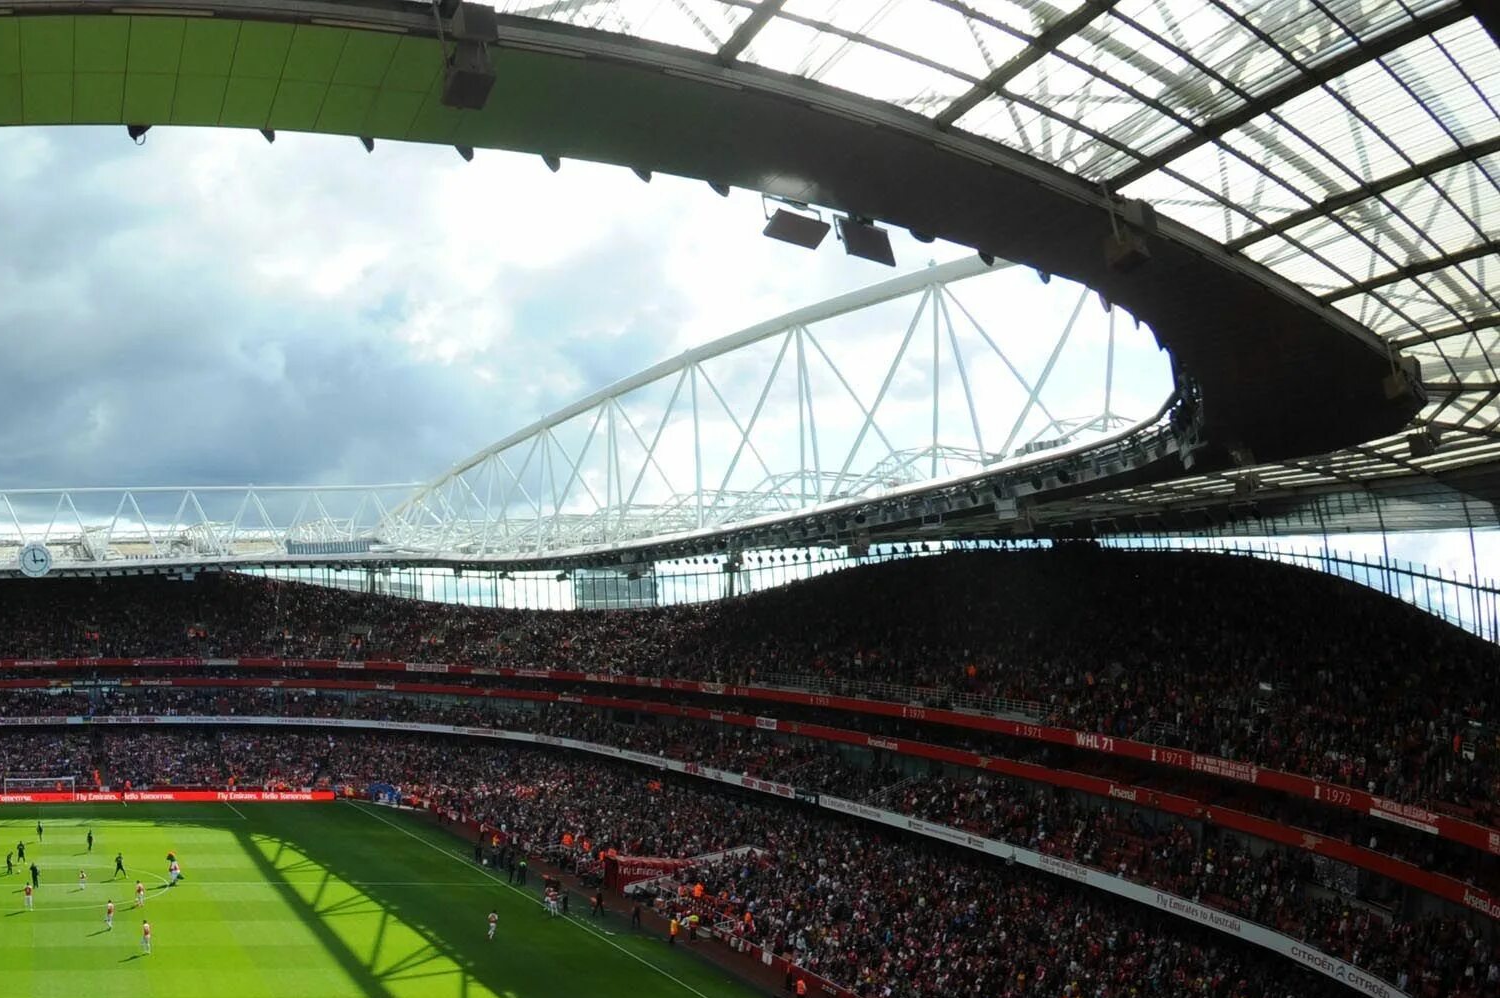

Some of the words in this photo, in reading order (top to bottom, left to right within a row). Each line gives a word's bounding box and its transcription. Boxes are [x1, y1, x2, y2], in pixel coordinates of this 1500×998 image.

[1023, 726, 1043, 738] 1971
[1075, 731, 1100, 750] WHL
[1101, 737, 1115, 752] 71
[1161, 750, 1183, 766] 1971
[1108, 784, 1137, 801] Arsenal
[1326, 788, 1352, 806] 1979
[1156, 893, 1168, 907] Fly
[1169, 895, 1199, 917] Emirates
[1208, 912, 1241, 933] Australia
[1291, 946, 1335, 973] CITROËN
